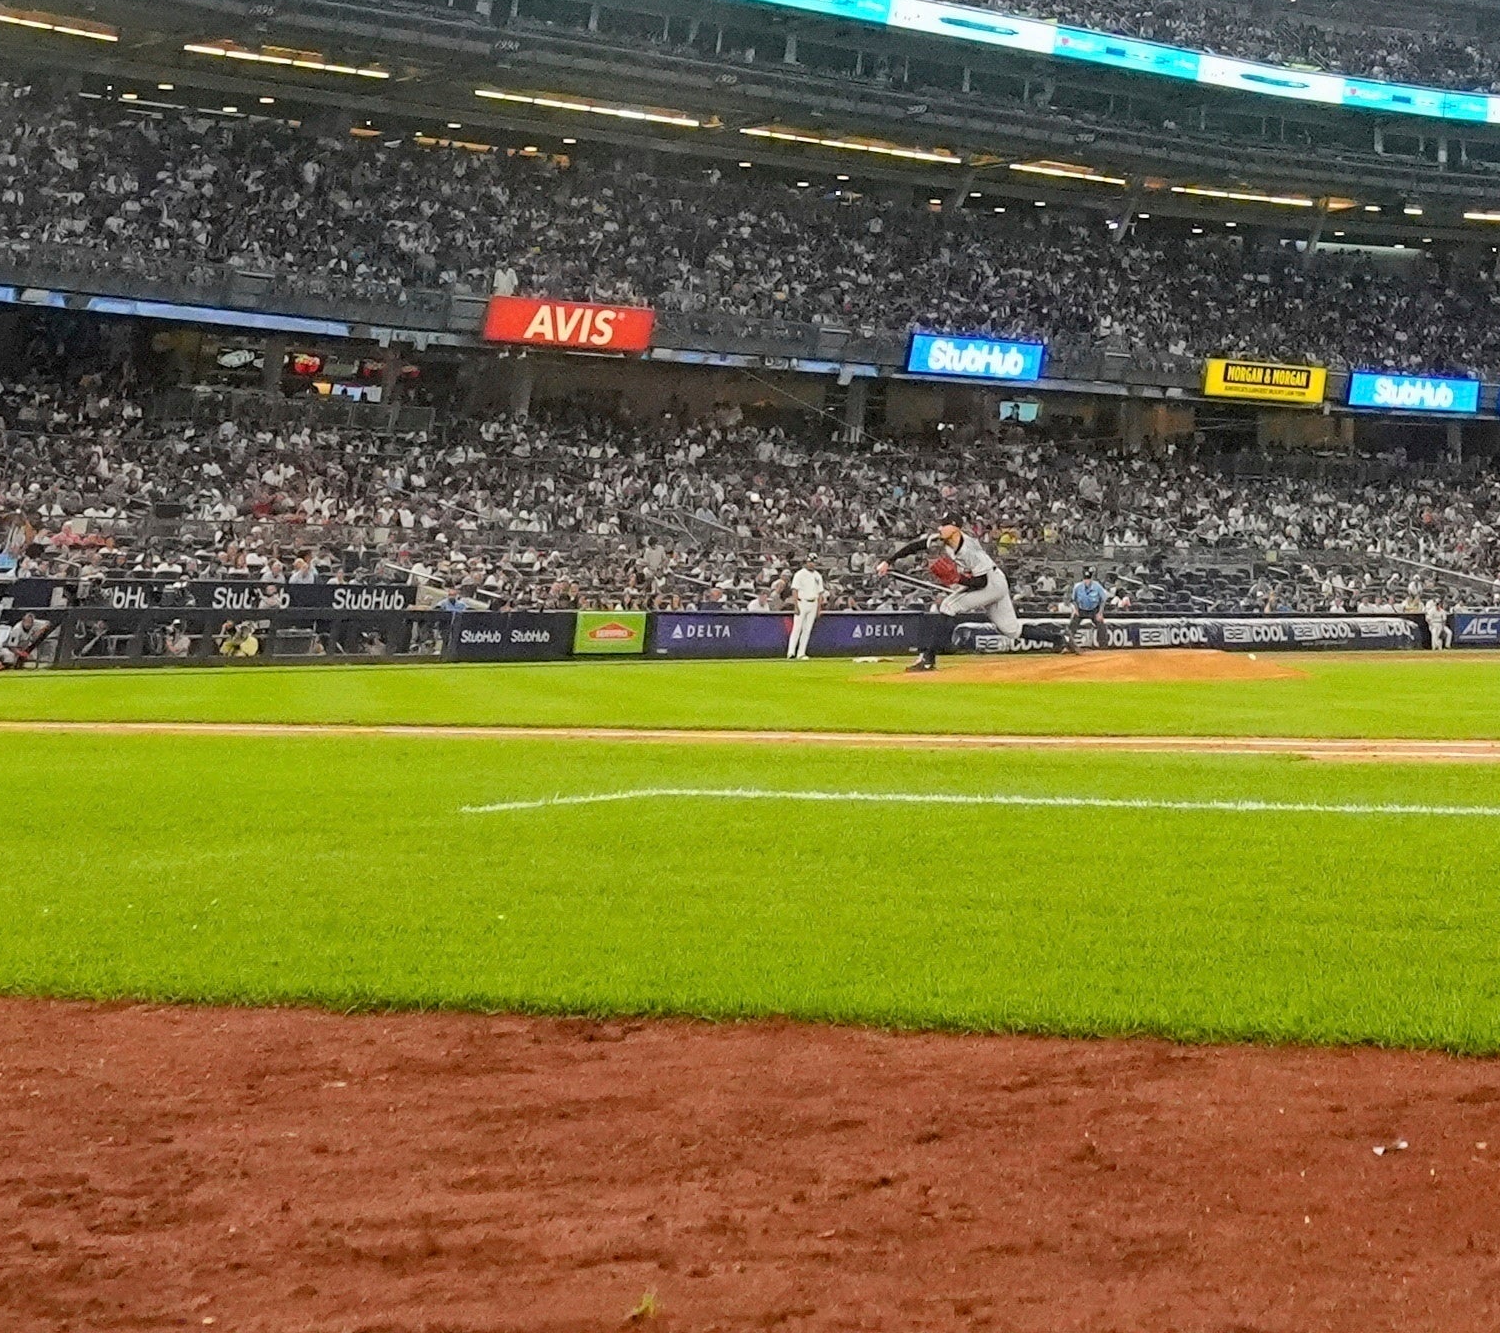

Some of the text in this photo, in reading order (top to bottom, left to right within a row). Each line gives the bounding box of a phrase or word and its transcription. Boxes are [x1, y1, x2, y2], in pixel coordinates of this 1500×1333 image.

[522, 304, 616, 346] AVIS
[927, 339, 1025, 376] StubHub
[1227, 365, 1308, 387] MORGAN & MORGAN
[1373, 379, 1454, 408] StubHub
[331, 587, 406, 611] StubHub
[686, 624, 731, 638] DELTA
[863, 624, 905, 637] DELTA
[1171, 626, 1208, 645] COOL
[1252, 624, 1289, 643] COOL
[1465, 618, 1499, 634] ACC
[460, 629, 502, 644] StubHub
